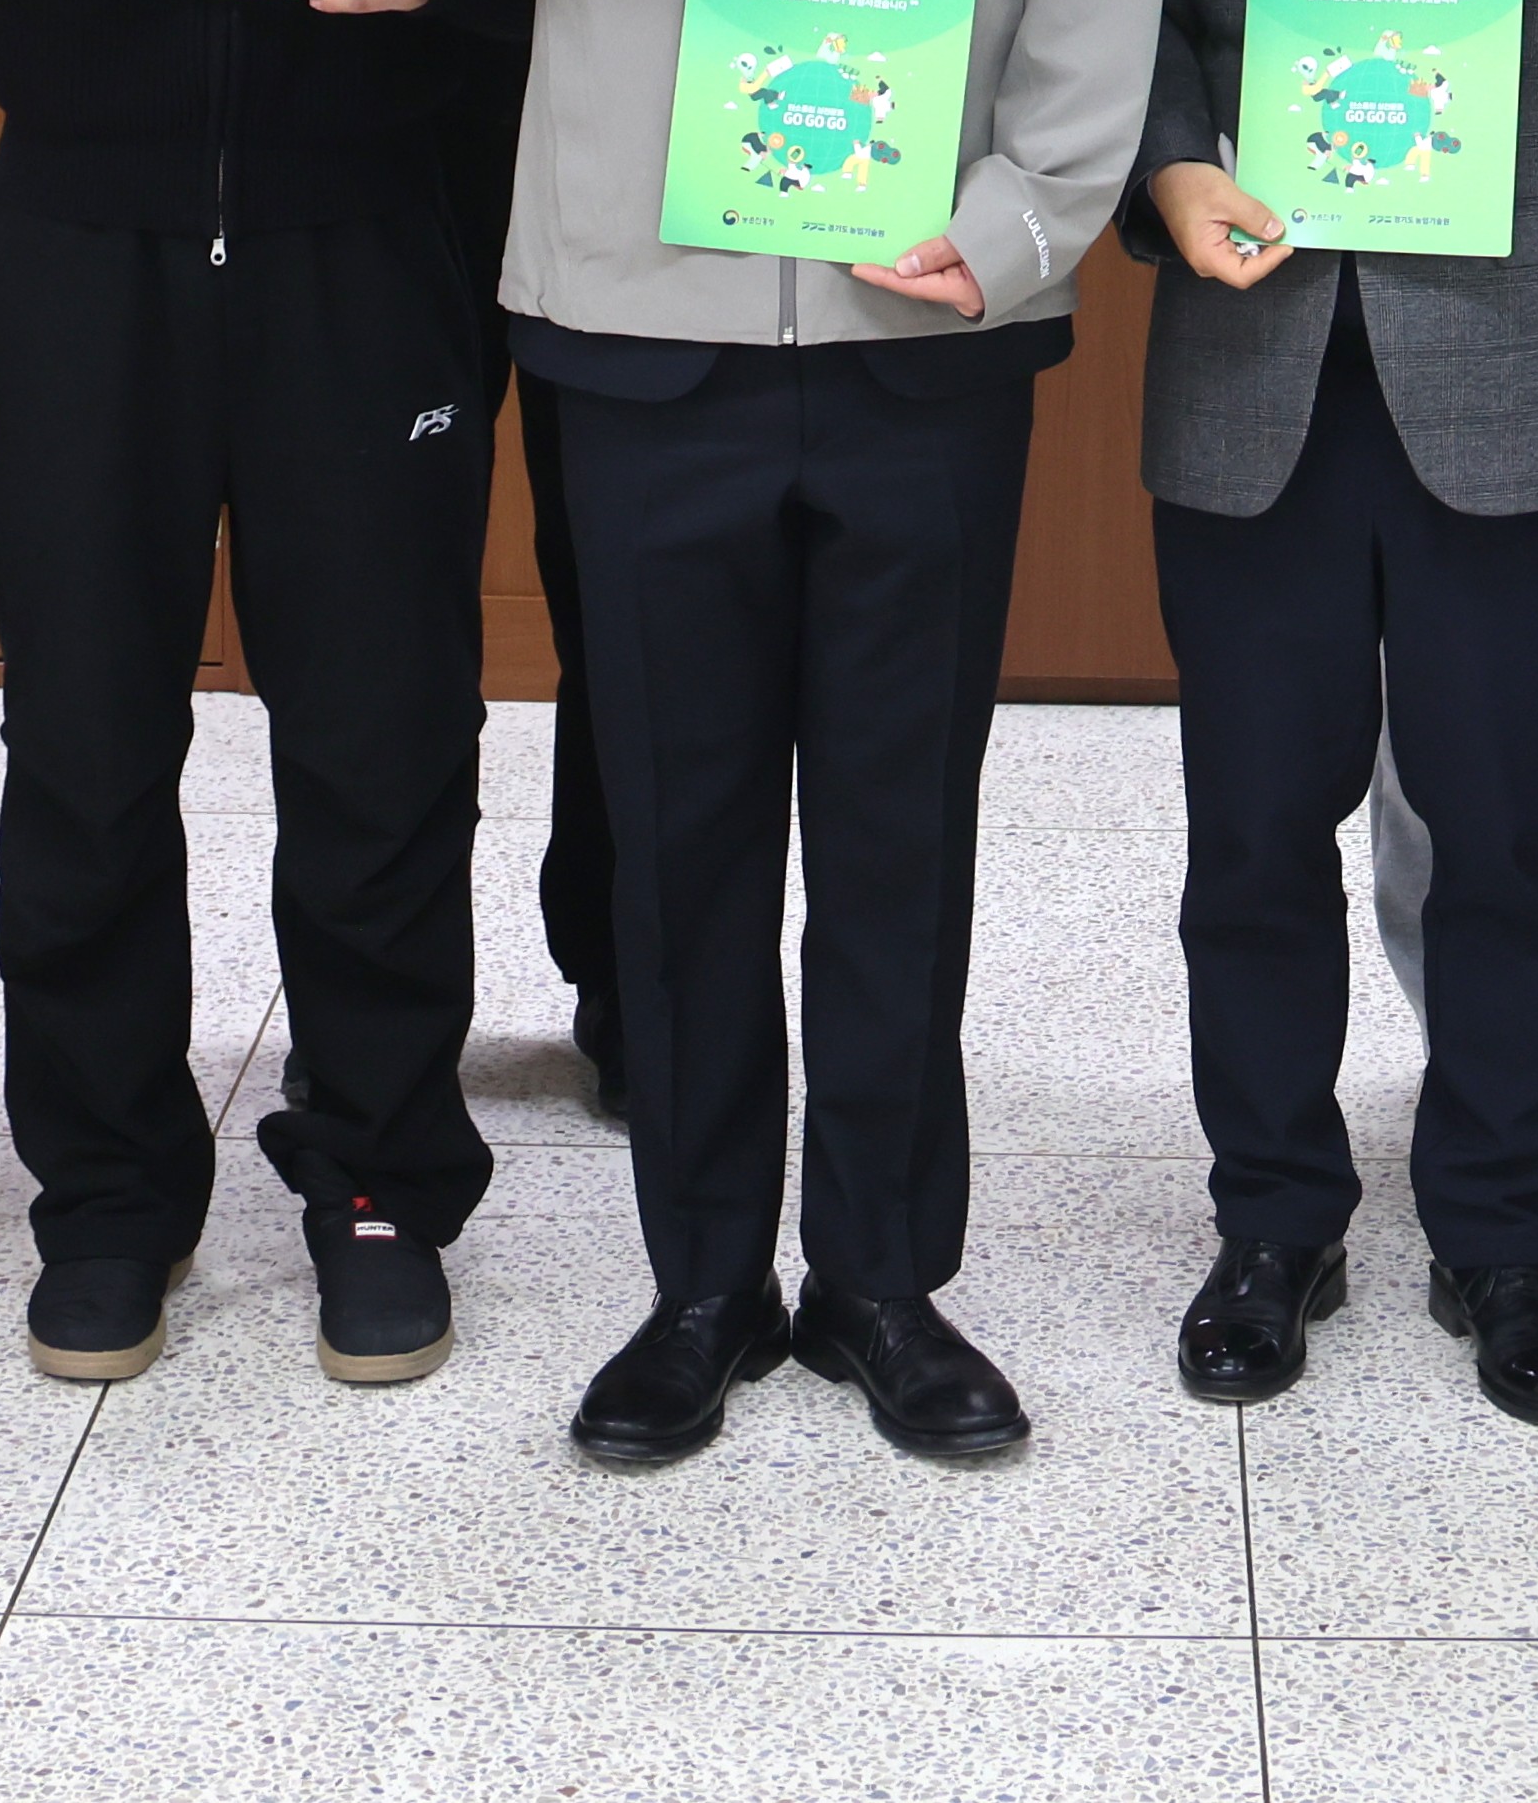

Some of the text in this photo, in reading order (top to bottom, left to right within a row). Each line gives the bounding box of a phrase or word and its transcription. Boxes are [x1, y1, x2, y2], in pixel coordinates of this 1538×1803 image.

[782, 110, 803, 125] GO
[804, 113, 825, 128] GO
[825, 115, 846, 130] GO
[1344, 108, 1406, 124] GO GO GO
